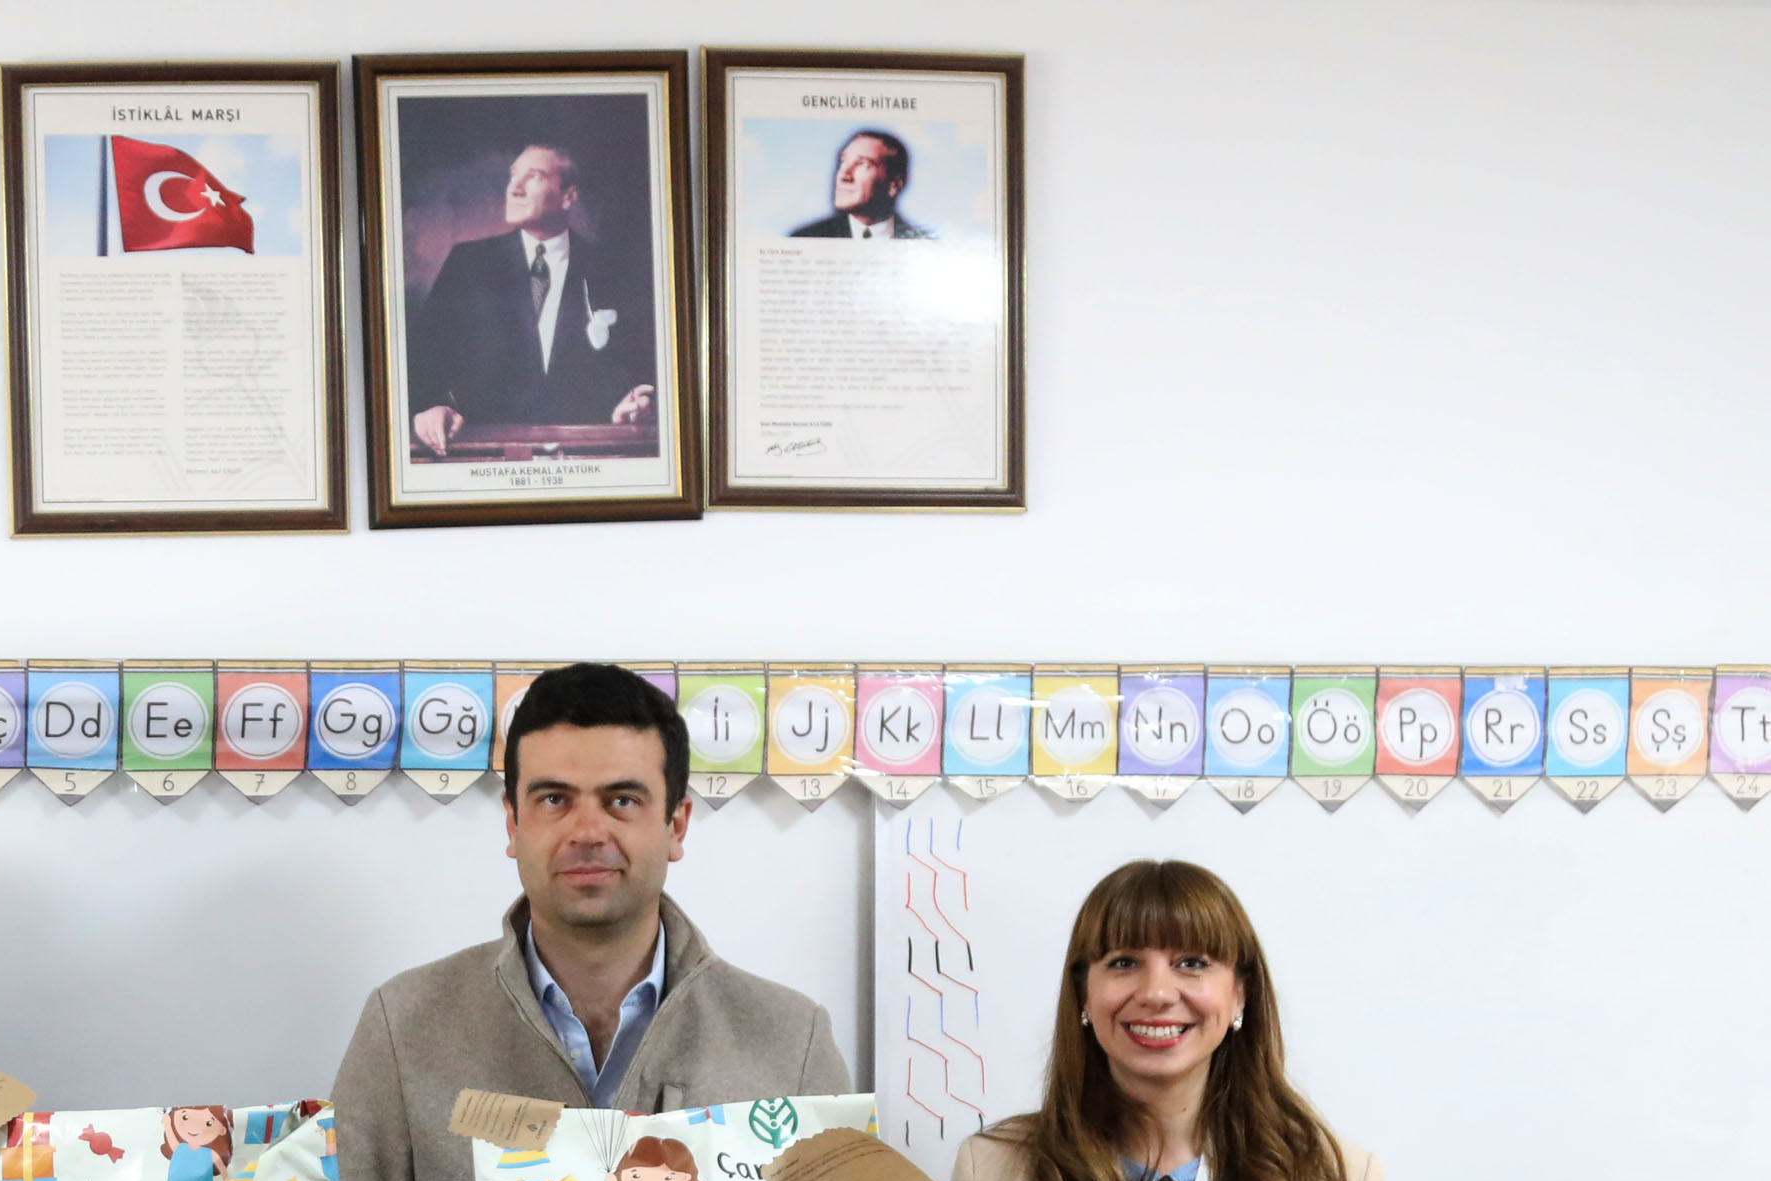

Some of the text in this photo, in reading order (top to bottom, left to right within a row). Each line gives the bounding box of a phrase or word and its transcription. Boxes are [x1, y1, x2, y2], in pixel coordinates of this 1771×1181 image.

[802, 93, 918, 110] GENÇLİĞE HİTABE
[112, 105, 241, 123] İSTİKLÂL MARŞI
[470, 467, 517, 477] MUSTAFA
[519, 466, 553, 476] KEMAL
[510, 478, 531, 487] 1881
[44, 701, 102, 739] Dd
[146, 702, 194, 738] Ee
[240, 702, 286, 738] Ff
[792, 701, 830, 752] Jj
[879, 705, 921, 743] Kk
[1044, 707, 1106, 740] Mm
[1399, 707, 1438, 758] Pp
[1484, 708, 1525, 745] Rr
[64, 773, 76, 791] 5
[163, 773, 175, 792] 6
[253, 774, 266, 793] 7
[346, 772, 357, 791] 8
[439, 773, 450, 792] 9
[706, 776, 727, 796] 12
[799, 778, 821, 797] 13
[886, 780, 910, 799] 14
[977, 778, 998, 796] 15
[1067, 780, 1089, 796] 16
[1235, 781, 1255, 800] 18
[1322, 780, 1342, 800] 19
[1404, 778, 1429, 798] 20
[1492, 778, 1515, 798] 21
[1577, 779, 1601, 800] 22
[1654, 778, 1678, 798] 23
[1736, 775, 1762, 795] 24
